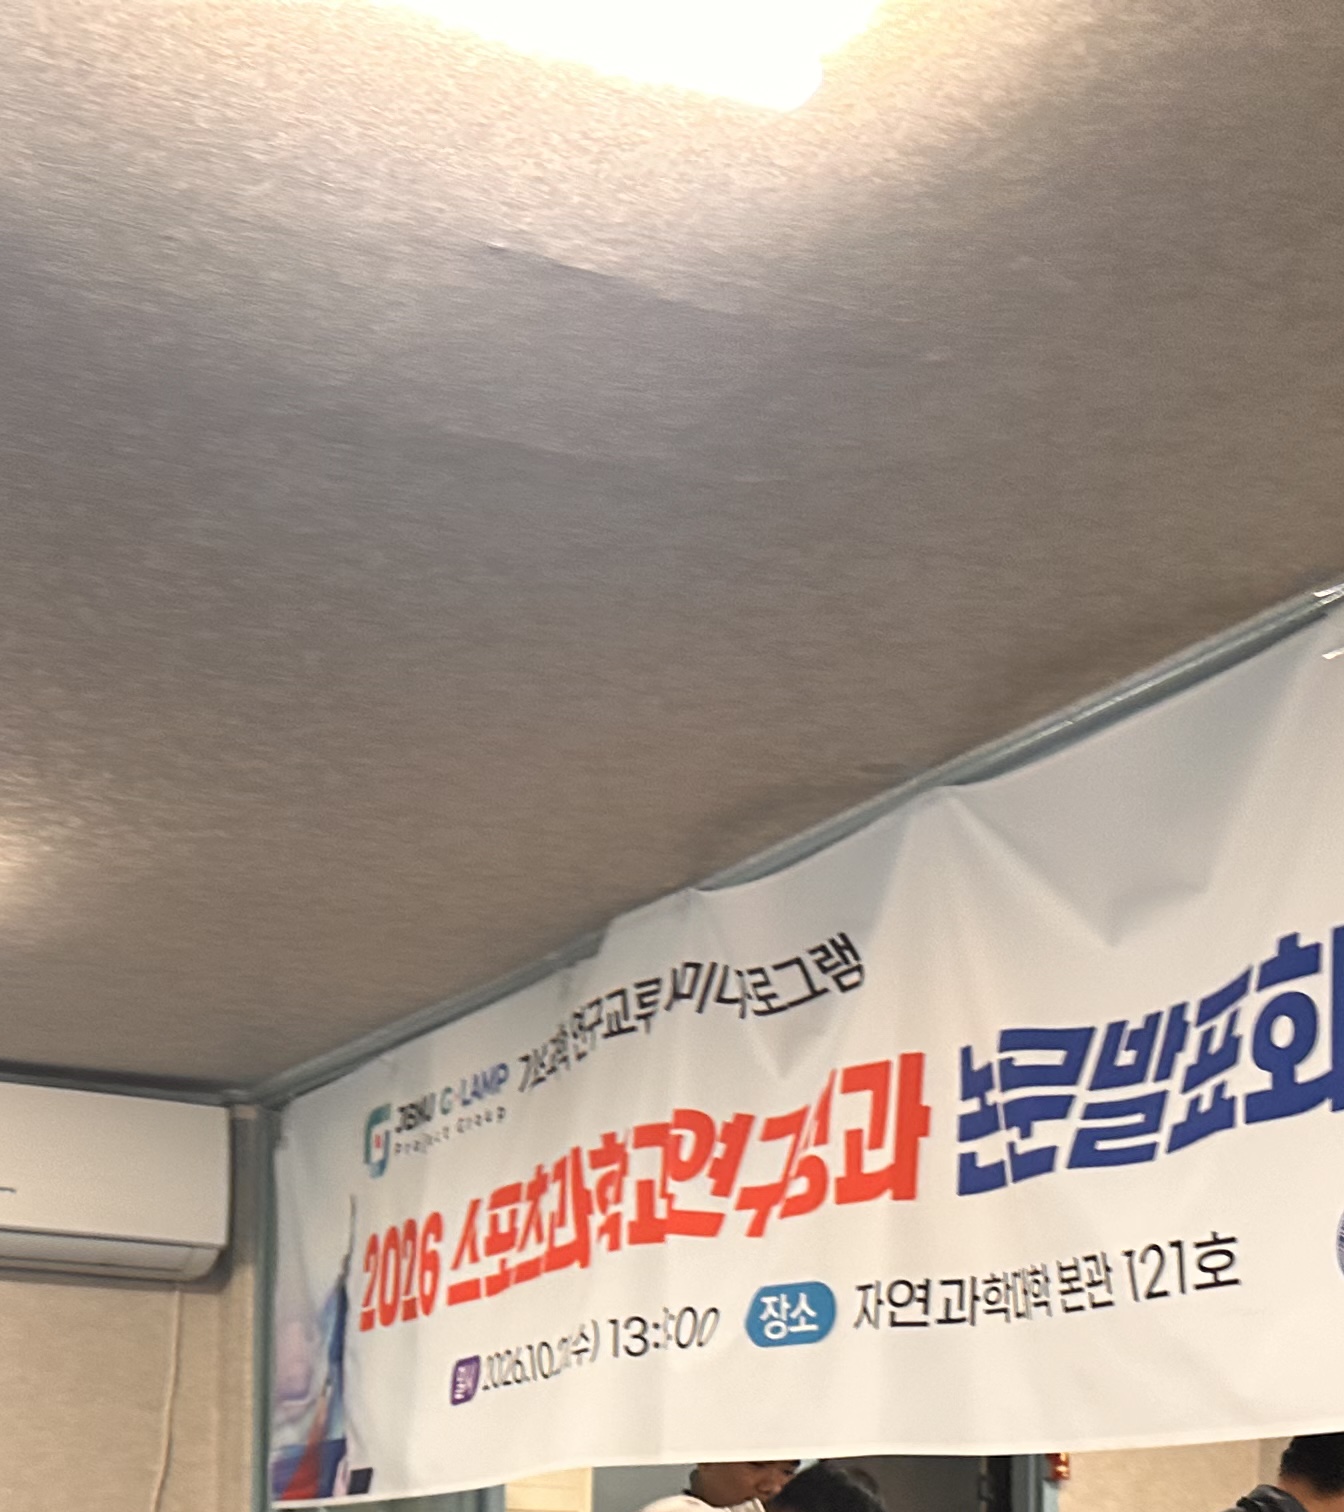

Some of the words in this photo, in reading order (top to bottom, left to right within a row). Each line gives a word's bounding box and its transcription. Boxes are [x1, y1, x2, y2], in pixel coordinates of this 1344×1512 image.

[359, 1210, 444, 1332] 2026
[759, 1292, 820, 1340] 장소
[1055, 1250, 1117, 1315] 본관
[1121, 1230, 1243, 1303] 121호
